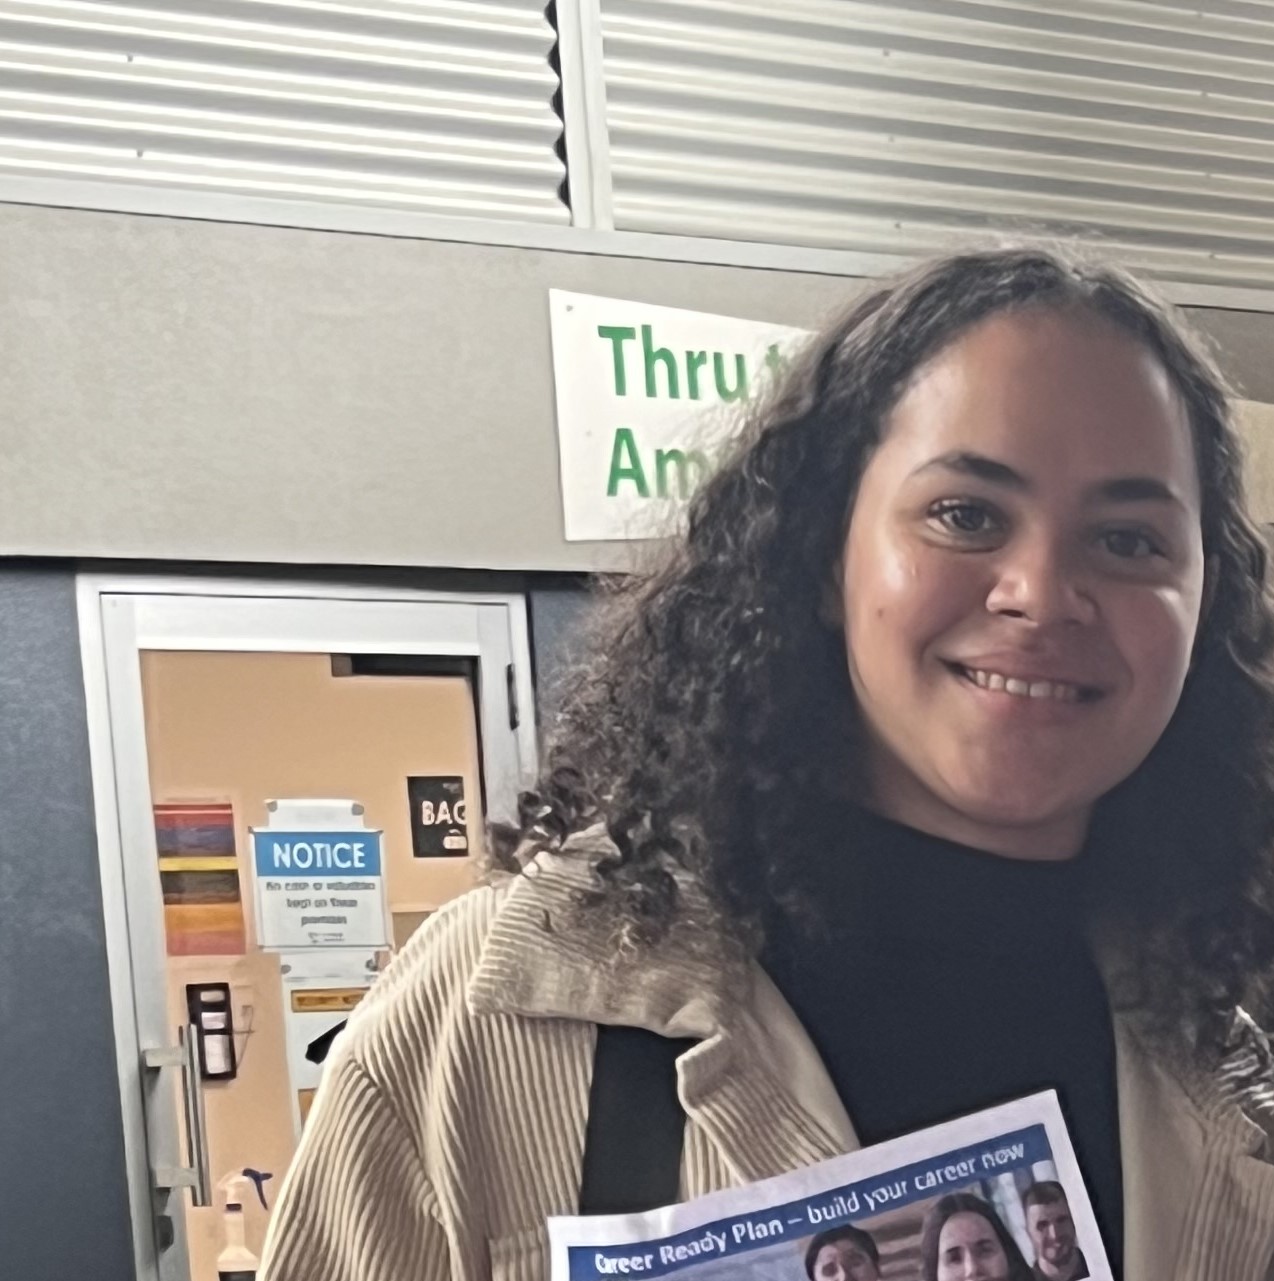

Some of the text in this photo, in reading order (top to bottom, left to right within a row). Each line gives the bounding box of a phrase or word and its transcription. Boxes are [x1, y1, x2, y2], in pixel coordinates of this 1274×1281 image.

[597, 324, 749, 403] Thru
[273, 842, 366, 868] NOTICE
[660, 1231, 727, 1265] Ready
[732, 1217, 784, 1244] Plan
[807, 1191, 861, 1224] build
[863, 1181, 908, 1211] your
[914, 1157, 976, 1191] career
[982, 1142, 1025, 1169] now
